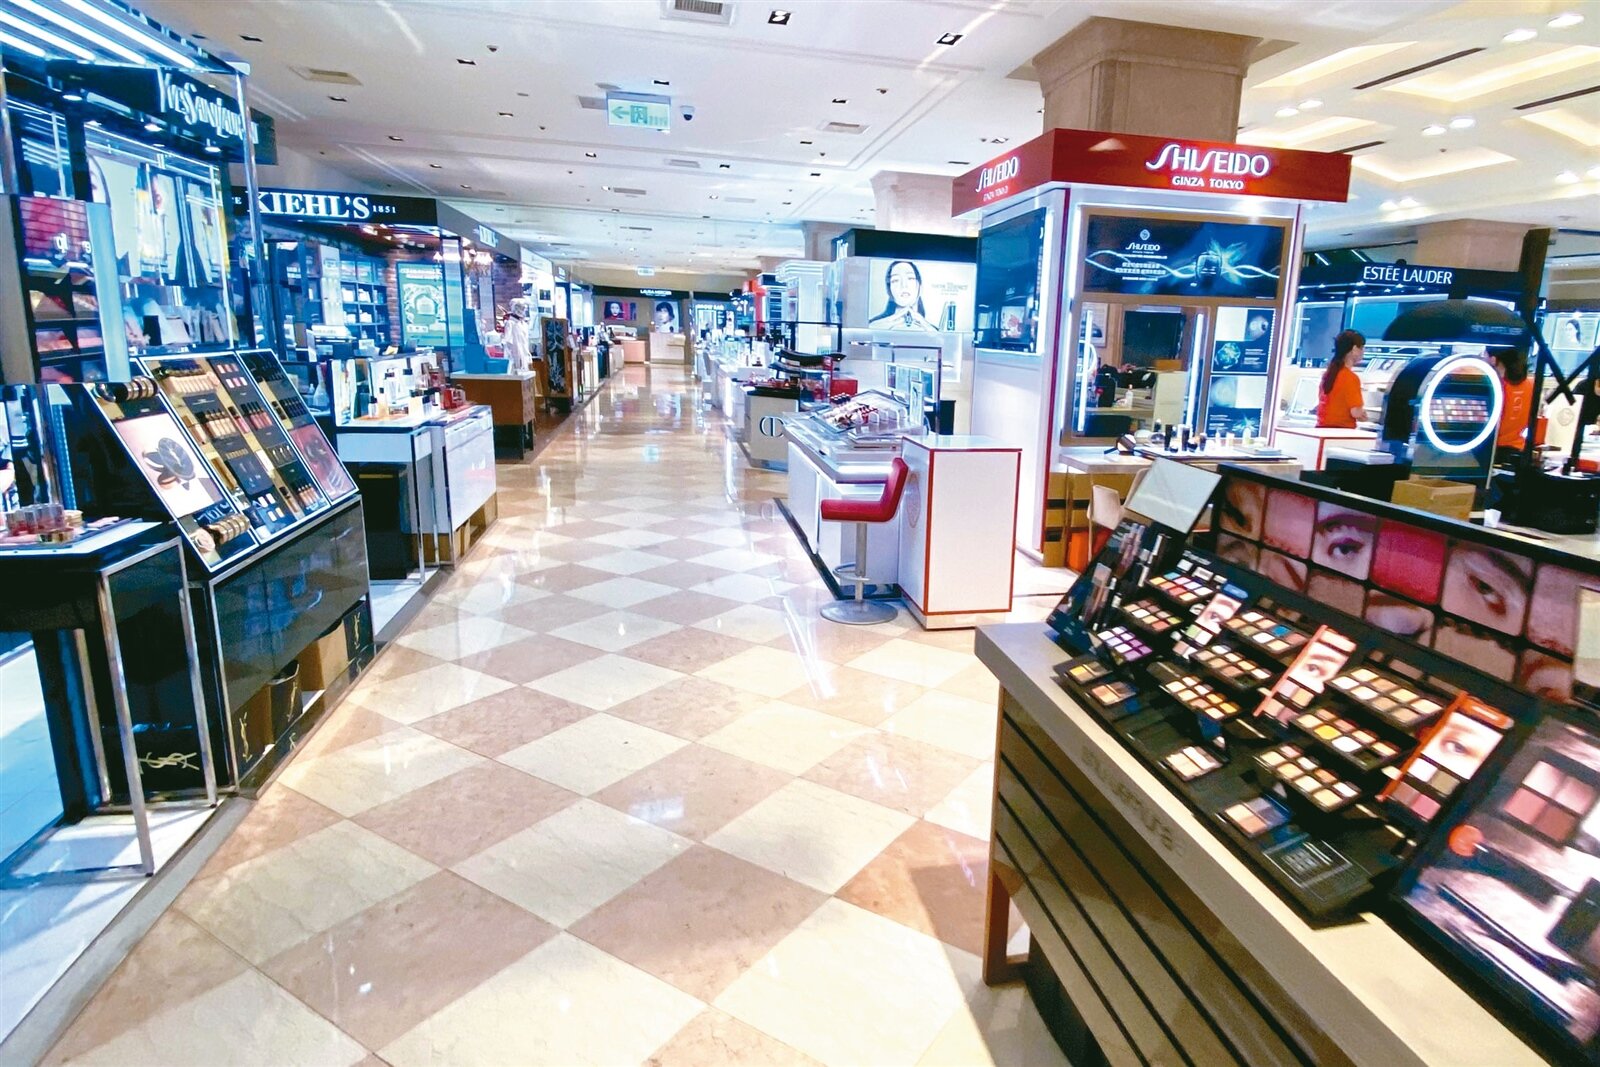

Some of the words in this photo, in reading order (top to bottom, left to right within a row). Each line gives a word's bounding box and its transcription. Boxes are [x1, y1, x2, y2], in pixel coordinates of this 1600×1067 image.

[1145, 144, 1270, 177] SHISEIDO
[975, 156, 1018, 193] SHISEIDO
[1172, 175, 1205, 187] GINZA
[1209, 178, 1244, 190] TOKYO
[245, 190, 370, 220] KIEHL'S
[372, 204, 397, 214] 1851
[1125, 242, 1161, 252] SHISEIDO
[1403, 269, 1453, 285] LAUDER
